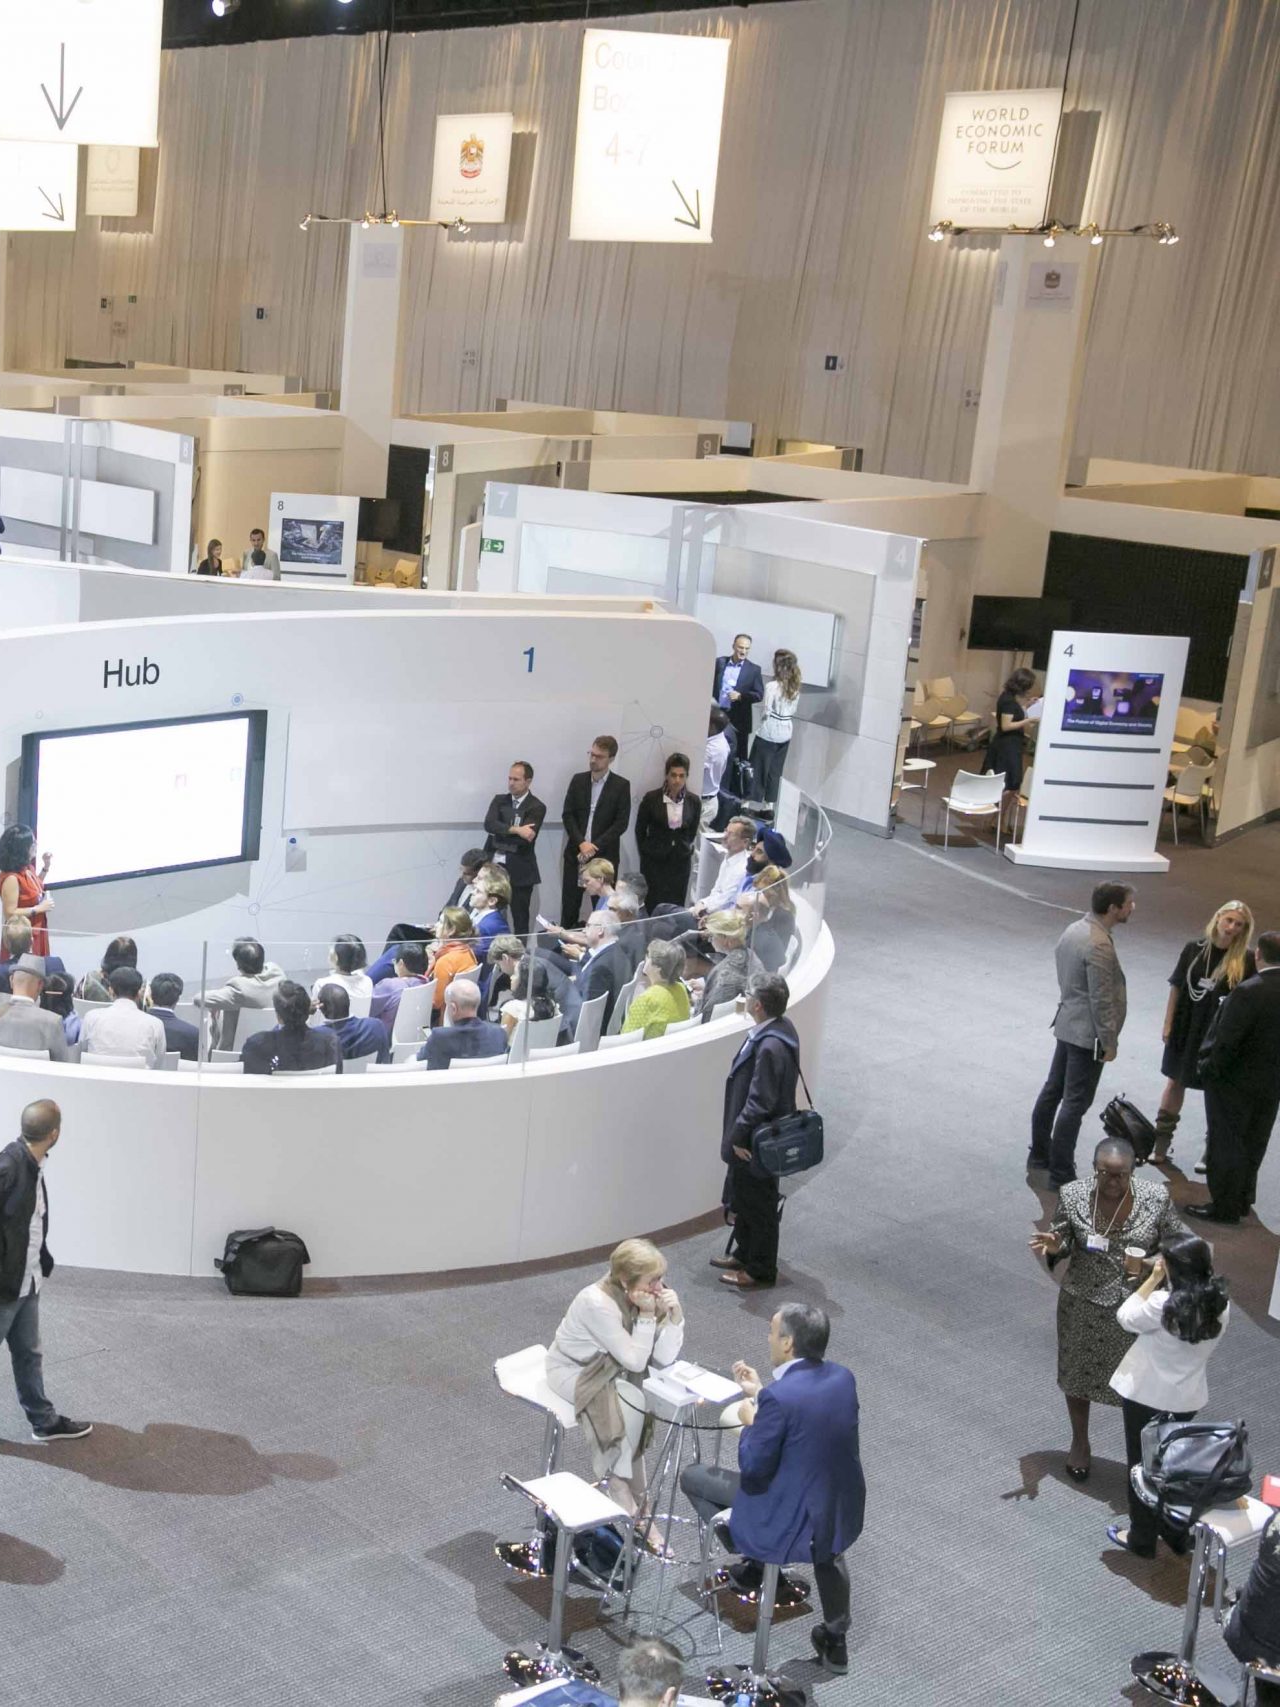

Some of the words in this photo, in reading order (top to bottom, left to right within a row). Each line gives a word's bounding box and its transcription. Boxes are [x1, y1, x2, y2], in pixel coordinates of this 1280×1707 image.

[971, 107, 1030, 122] WORLD
[955, 123, 1045, 139] ECONOMIC
[967, 140, 1025, 154] FORUM
[182, 440, 190, 457] 8
[703, 439, 712, 454] 9
[442, 451, 449, 467] 8
[277, 500, 284, 511] 8
[497, 491, 510, 509] 7
[894, 545, 907, 569] 4
[1063, 643, 1075, 658] 4
[523, 646, 535, 673] 1
[103, 656, 160, 689] Hub
